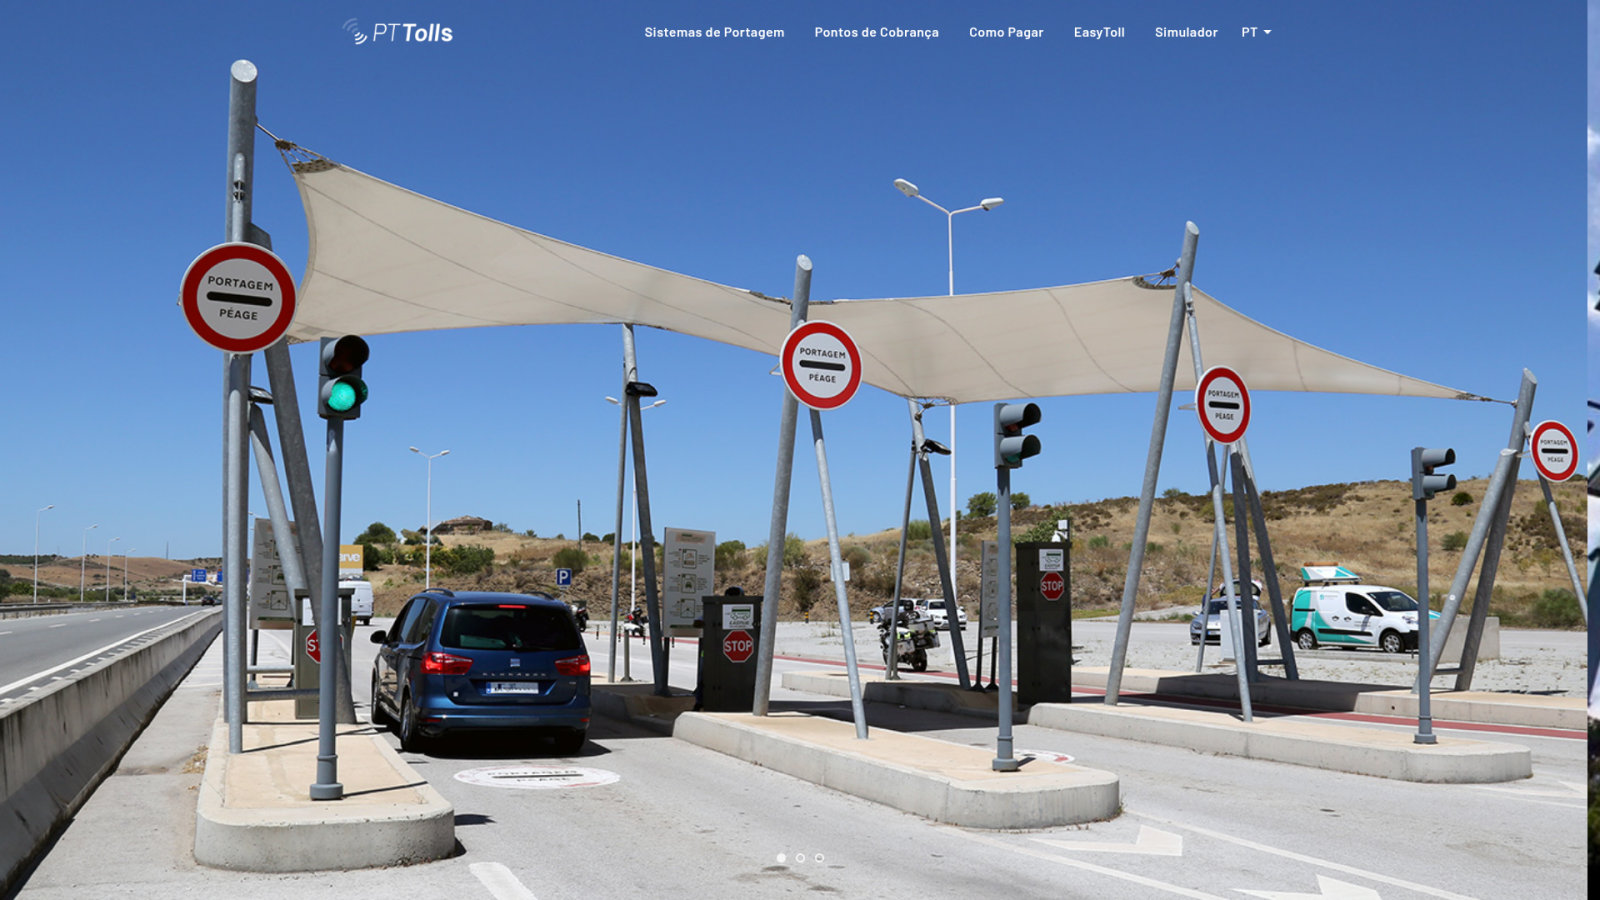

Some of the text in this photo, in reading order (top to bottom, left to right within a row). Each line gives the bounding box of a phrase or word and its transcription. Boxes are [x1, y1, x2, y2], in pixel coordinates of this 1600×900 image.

[208, 275, 274, 291] PORTAGEM
[219, 306, 258, 321] PÉAGE
[800, 347, 846, 359] PORTAGEM
[809, 372, 836, 384] PÉAGE
[1208, 389, 1240, 399] PORTAGEM
[559, 570, 569, 584] P
[1041, 580, 1064, 592] STOP
[724, 640, 753, 653] STOP
